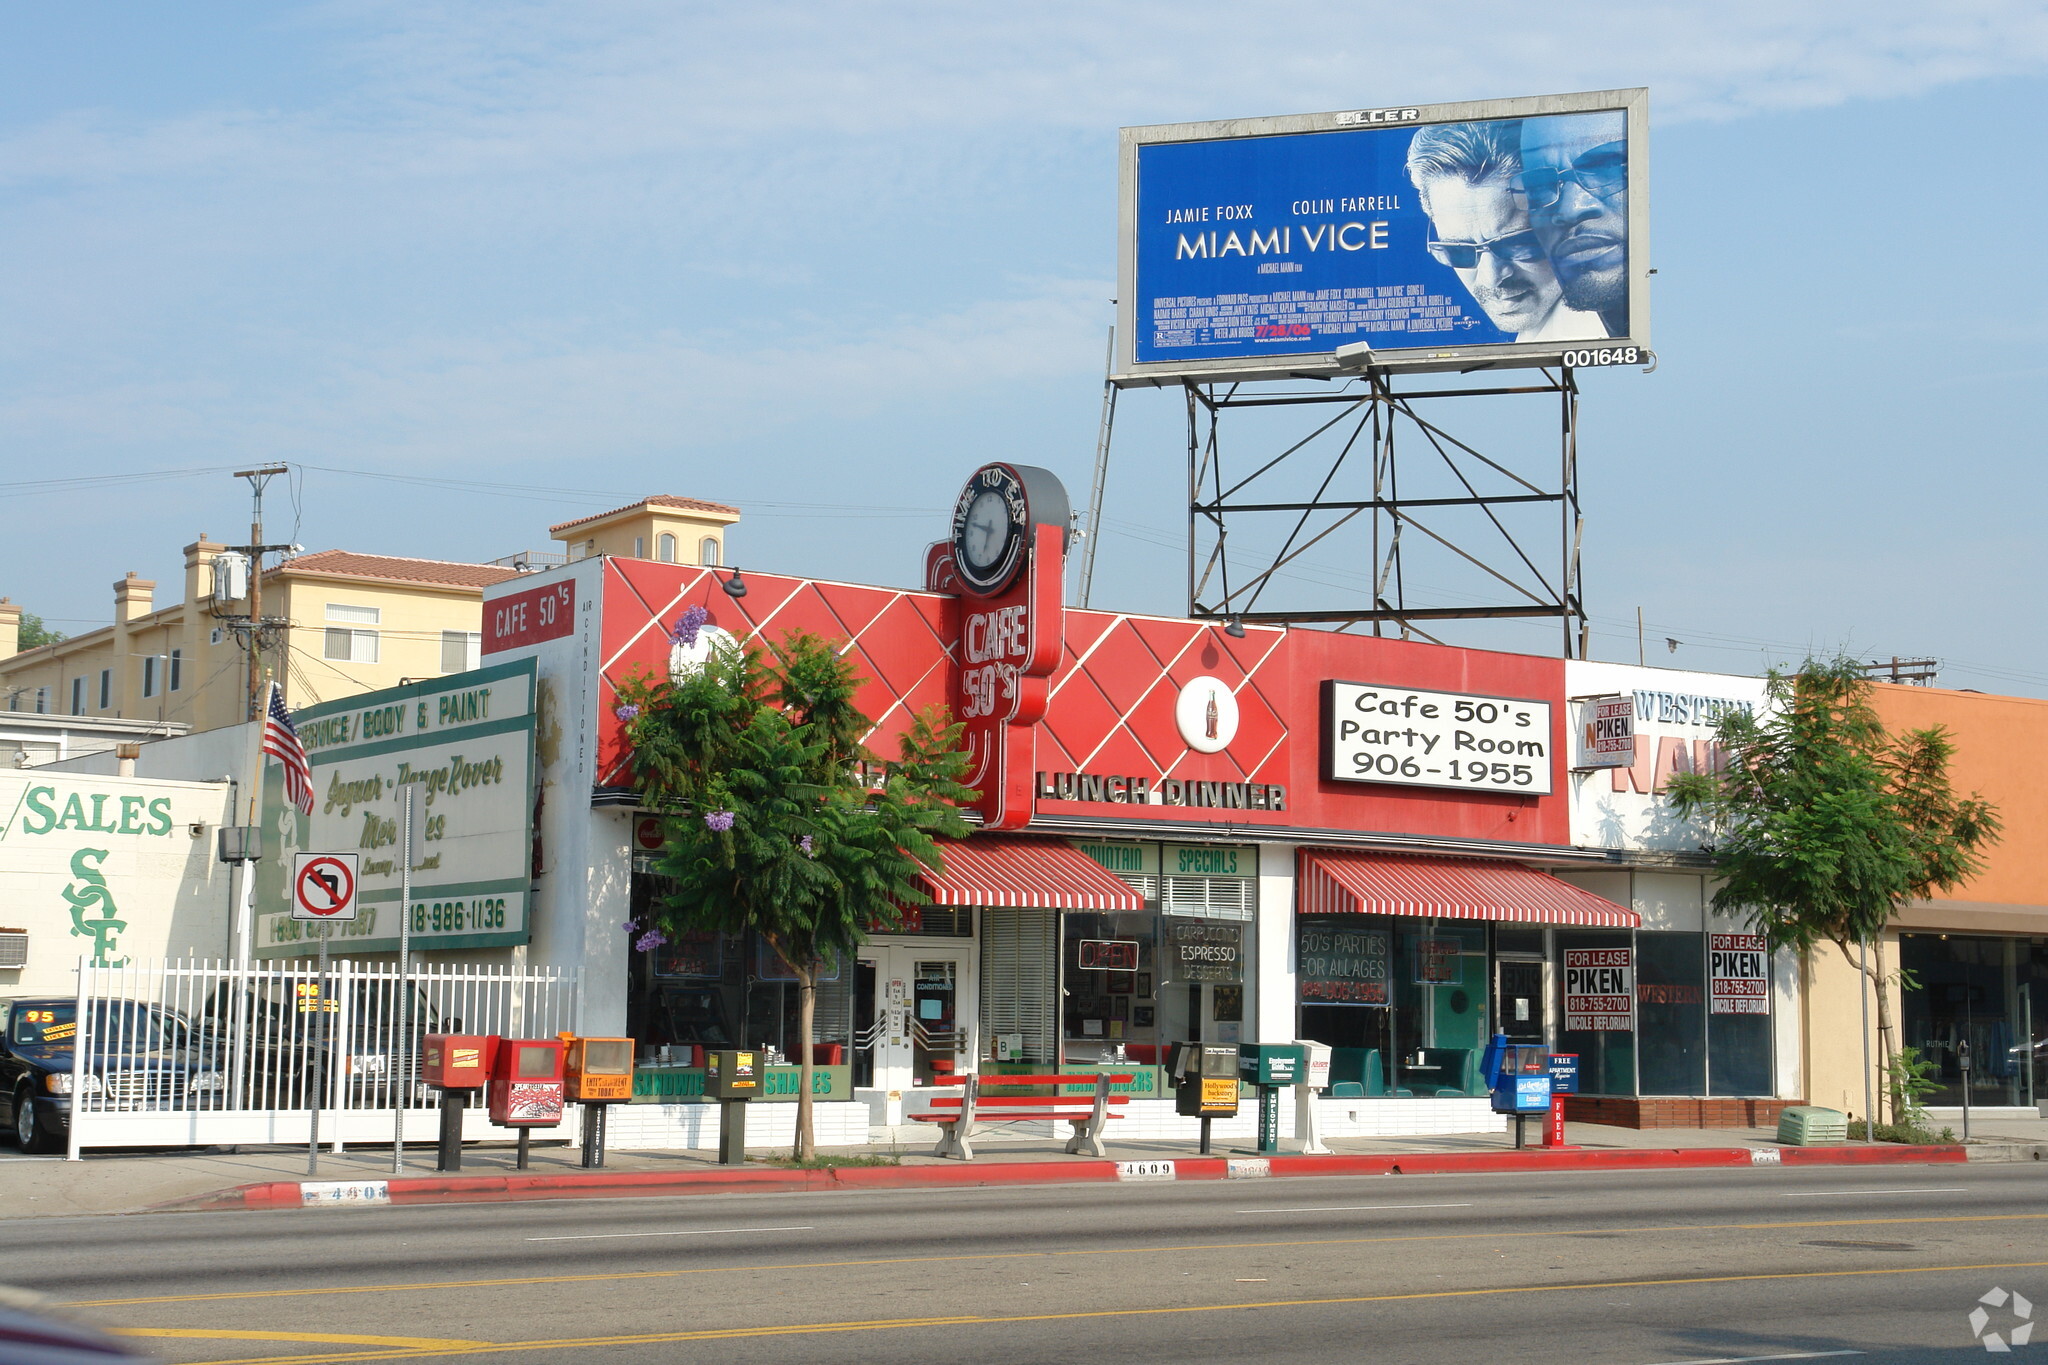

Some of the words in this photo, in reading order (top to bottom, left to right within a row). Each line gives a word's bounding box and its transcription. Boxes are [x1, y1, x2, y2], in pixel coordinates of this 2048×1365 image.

[1166, 207, 1209, 224] JAMIE
[1217, 204, 1253, 221] FOXX
[1293, 199, 1334, 215] COLIN
[1341, 195, 1400, 212] FARRELL
[1175, 225, 1291, 260] MIAMI
[1300, 220, 1388, 252] VICE
[1261, 263, 1280, 274] MICHAEL
[1280, 262, 1294, 273] MANN
[1255, 324, 1311, 338] 7/28/06
[1563, 347, 1638, 368] 001648
[582, 600, 593, 613] AIR
[495, 601, 528, 639] CAFE
[964, 605, 1027, 664] CAFE
[439, 688, 491, 725] PAINT
[1355, 692, 1439, 718] Cafe
[1454, 700, 1531, 727] 50's
[1598, 706, 1610, 717] FOR
[1611, 703, 1631, 716] LEASE
[1597, 717, 1628, 739] PIKEN
[1340, 720, 1440, 755] Party
[1454, 730, 1544, 757] Room
[1352, 752, 1533, 785] 906-1955
[323, 770, 382, 818] Jaguar
[1036, 771, 1149, 805] LUNCH
[1162, 778, 1287, 811] DINNER
[1178, 848, 1237, 874] SPECIALS
[1334, 934, 1386, 955] PARTIES
[1712, 935, 1731, 950] FOR
[1734, 935, 1764, 950] LEASE
[1081, 942, 1138, 969] OPEN
[1181, 945, 1236, 961] ESPRESSO
[1568, 951, 1591, 966] FOR
[1593, 951, 1629, 966] LEASE
[1183, 964, 1233, 981] DESSERTS
[1301, 957, 1326, 977] FOR
[1329, 958, 1351, 978] ALL
[1351, 959, 1386, 979] AGES
[1712, 952, 1761, 978] PIKEN
[916, 983, 954, 991] CONDITIONED
[928, 974, 941, 982] AIR
[1567, 968, 1624, 994] PIKEN
[1714, 981, 1765, 994] 818-755-2700
[297, 983, 319, 996] 96
[1637, 984, 1699, 1004] WESTERN
[1569, 997, 1629, 1011] 818-755-2700
[1714, 999, 1734, 1013] NICOLE
[1735, 998, 1766, 1014] DEFLORIAN
[27, 1010, 54, 1022] 95
[1568, 1015, 1592, 1031] NICOLE
[1594, 1014, 1630, 1031] DEFLORIAN
[1000, 1041, 1007, 1053] B
[1926, 1040, 1949, 1048] RUTHIE
[597, 1087, 615, 1097] TODAY
[765, 1072, 831, 1094] SHAES
[1269, 1093, 1277, 1143] EMPLOYMENT
[1126, 1163, 1170, 1175] 4609
